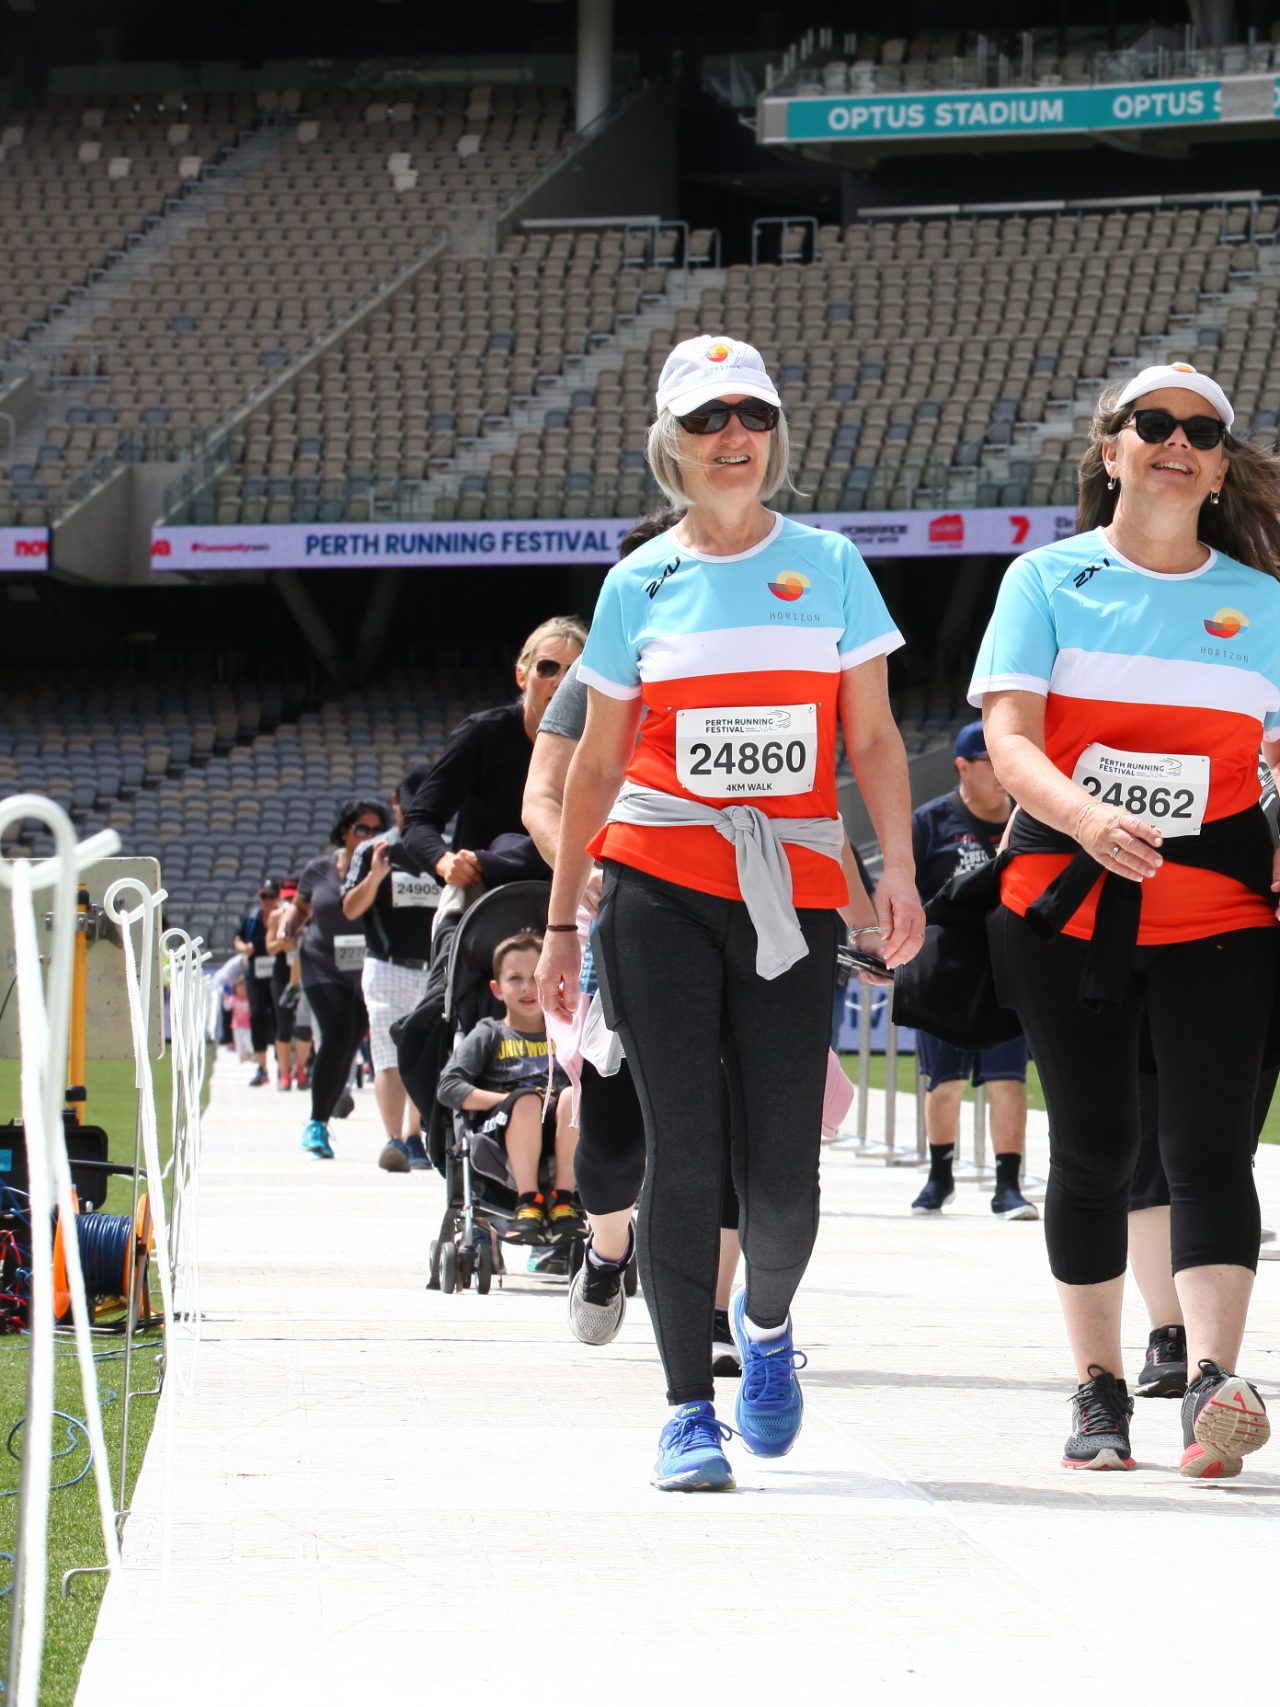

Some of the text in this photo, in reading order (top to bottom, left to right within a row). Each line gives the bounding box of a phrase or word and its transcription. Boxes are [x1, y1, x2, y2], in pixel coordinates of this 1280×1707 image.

[1112, 90, 1204, 119] OPTUS
[827, 98, 1064, 131] OPTUS STADIUM
[305, 534, 379, 557] PERTH
[387, 531, 496, 555] RUNNING
[502, 530, 610, 553] FESTIVAL
[644, 556, 681, 600] 2XU
[768, 611, 821, 622] HORIZON
[1200, 646, 1249, 664] HORIZON
[705, 718, 774, 726] PERTH RUNNING
[705, 726, 745, 734] FESTIVAL
[689, 740, 806, 775] 24860
[1100, 756, 1165, 772] PERTH RUNNING
[1099, 763, 1136, 777] FESTIVAL
[726, 783, 773, 792] 4KM WALK
[1082, 776, 1195, 819] 24862
[397, 882, 440, 896] 24905
